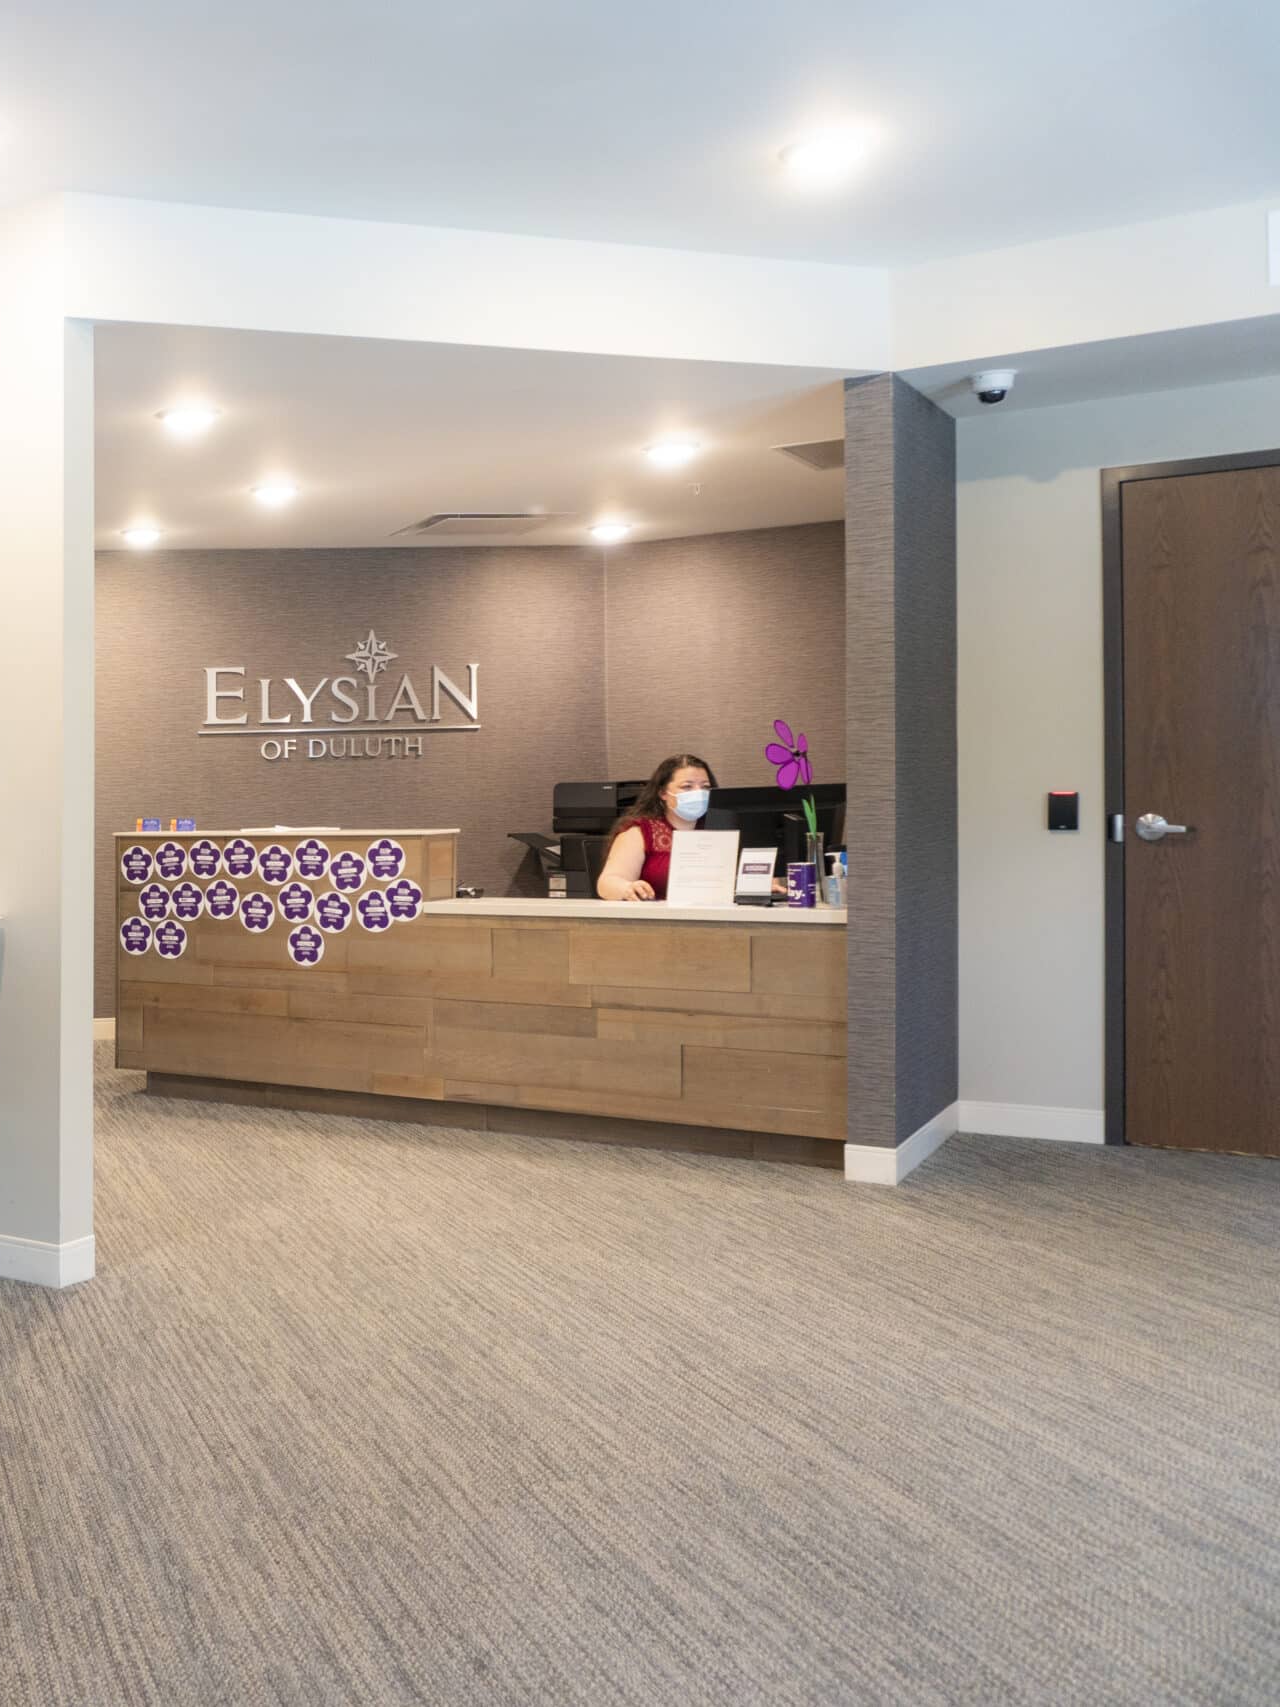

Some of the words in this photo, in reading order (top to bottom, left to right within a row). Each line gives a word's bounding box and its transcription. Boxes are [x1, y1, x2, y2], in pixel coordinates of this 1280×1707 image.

[202, 663, 480, 726] ELYSIAN
[260, 739, 297, 760] OF
[308, 736, 424, 759] DULUTH
